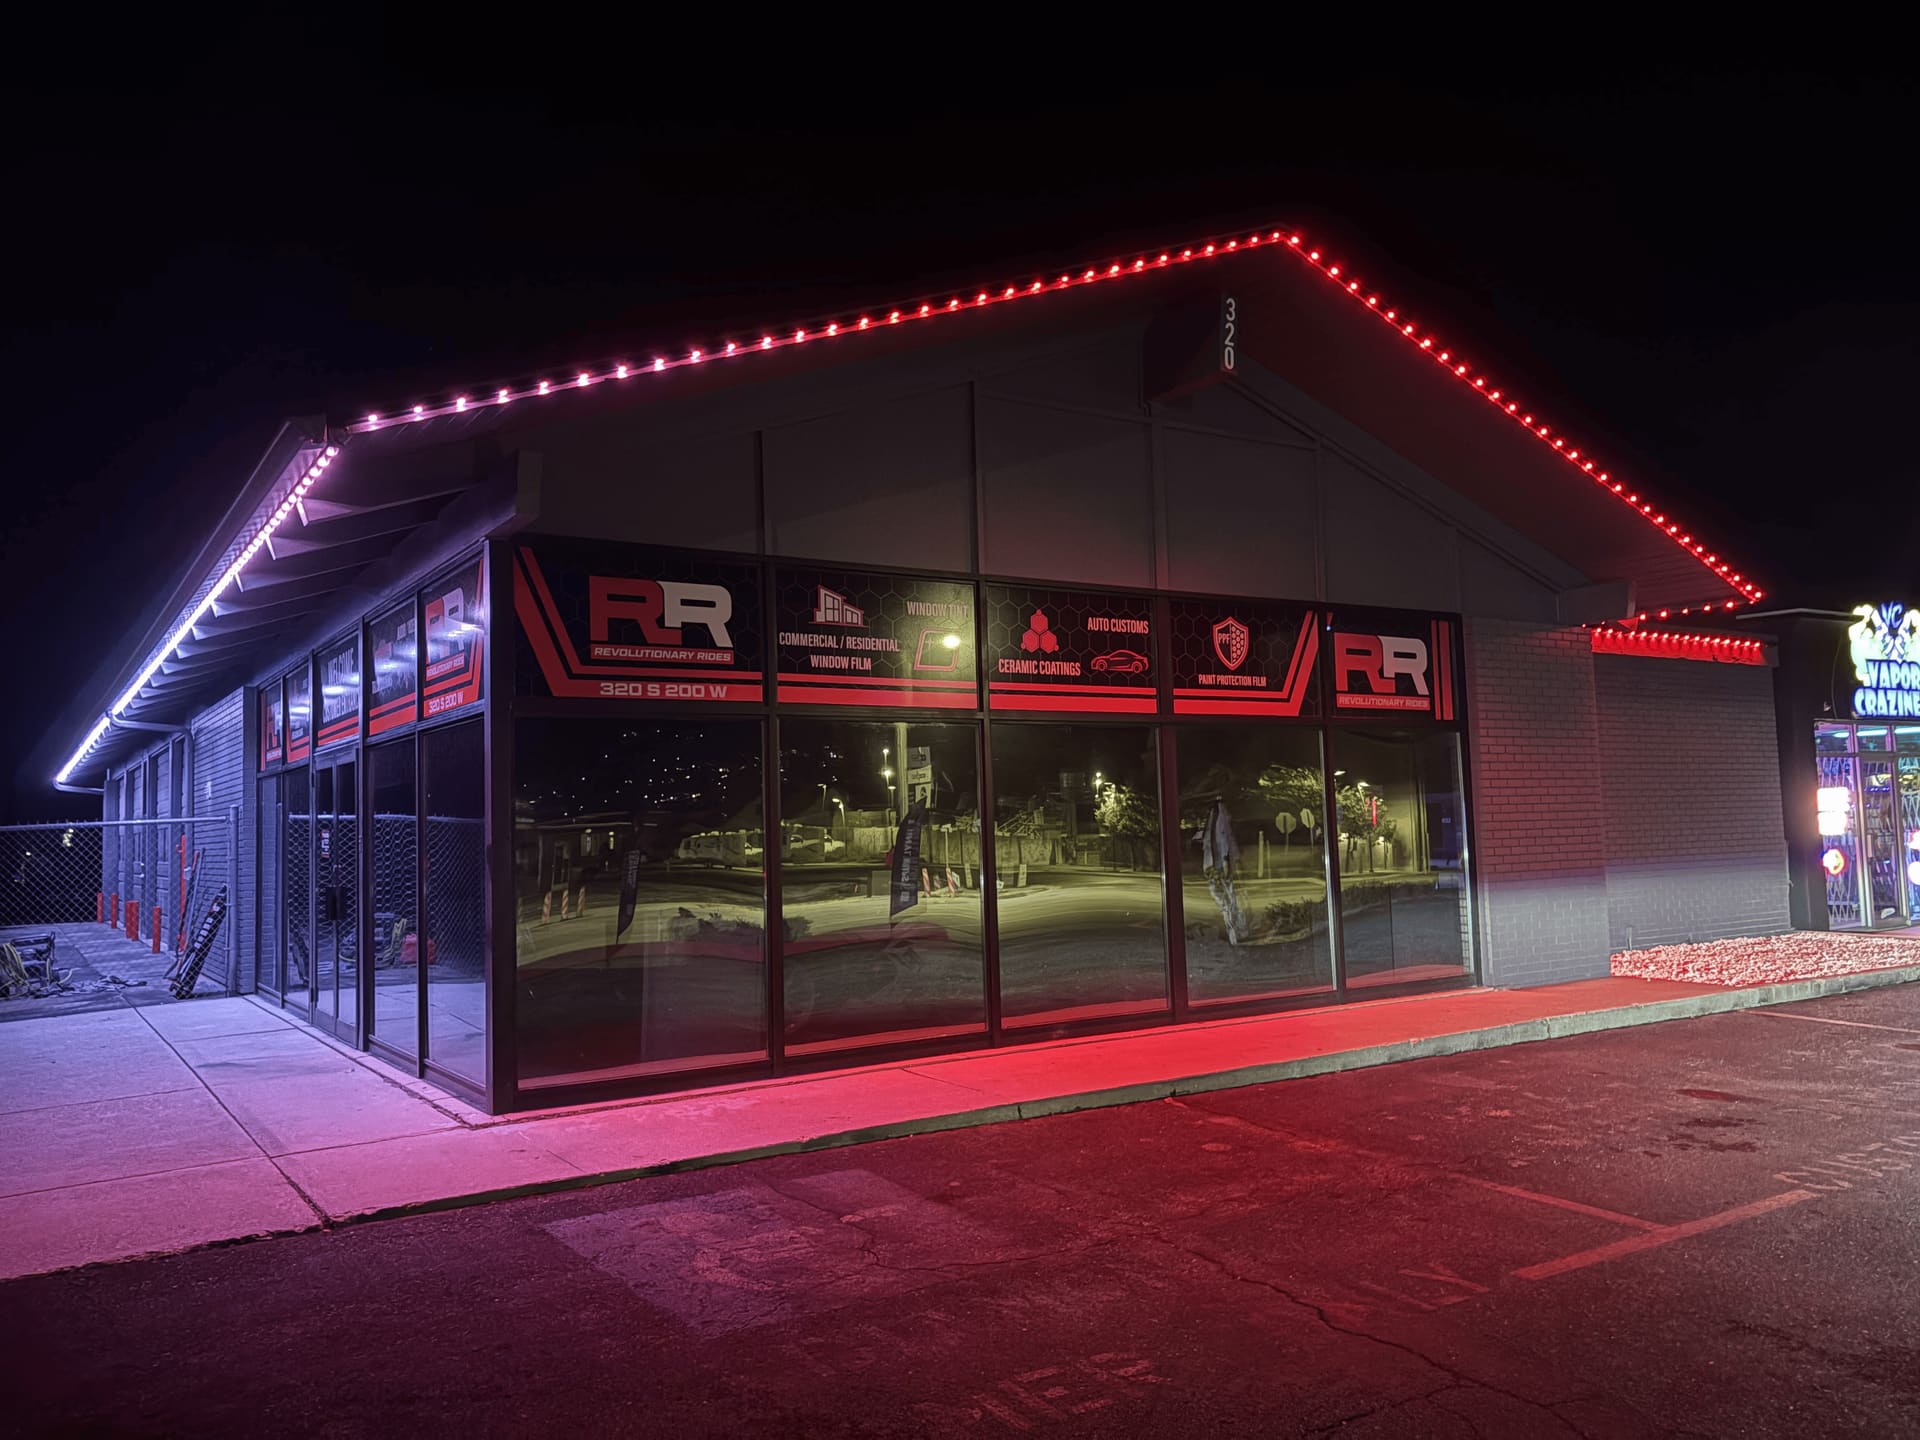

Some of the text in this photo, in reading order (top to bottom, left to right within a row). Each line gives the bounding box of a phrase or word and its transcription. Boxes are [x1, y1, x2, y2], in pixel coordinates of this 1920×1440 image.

[1224, 298, 1236, 370] 320
[589, 576, 734, 648] RR
[906, 601, 969, 618] WINDOW TINT
[1880, 601, 1904, 629] VC
[1088, 617, 1149, 634] AUTO CUSTOMS
[779, 632, 839, 649] COMMERCIAL
[846, 637, 900, 653] RESIDENTIAL
[1218, 632, 1231, 644] PPF
[594, 647, 732, 662] REVOLUTIONARY RIDES
[810, 655, 872, 671] WINDOW FILM
[998, 658, 1081, 676] CERAMIC COATINGS
[1334, 632, 1430, 695] RR
[1198, 673, 1267, 687] PAINT PROTECTION FILM
[1866, 660, 1920, 691] VAPOR
[600, 682, 728, 698] 320 S 200 W
[1340, 696, 1405, 707] REVOLUTIONARY
